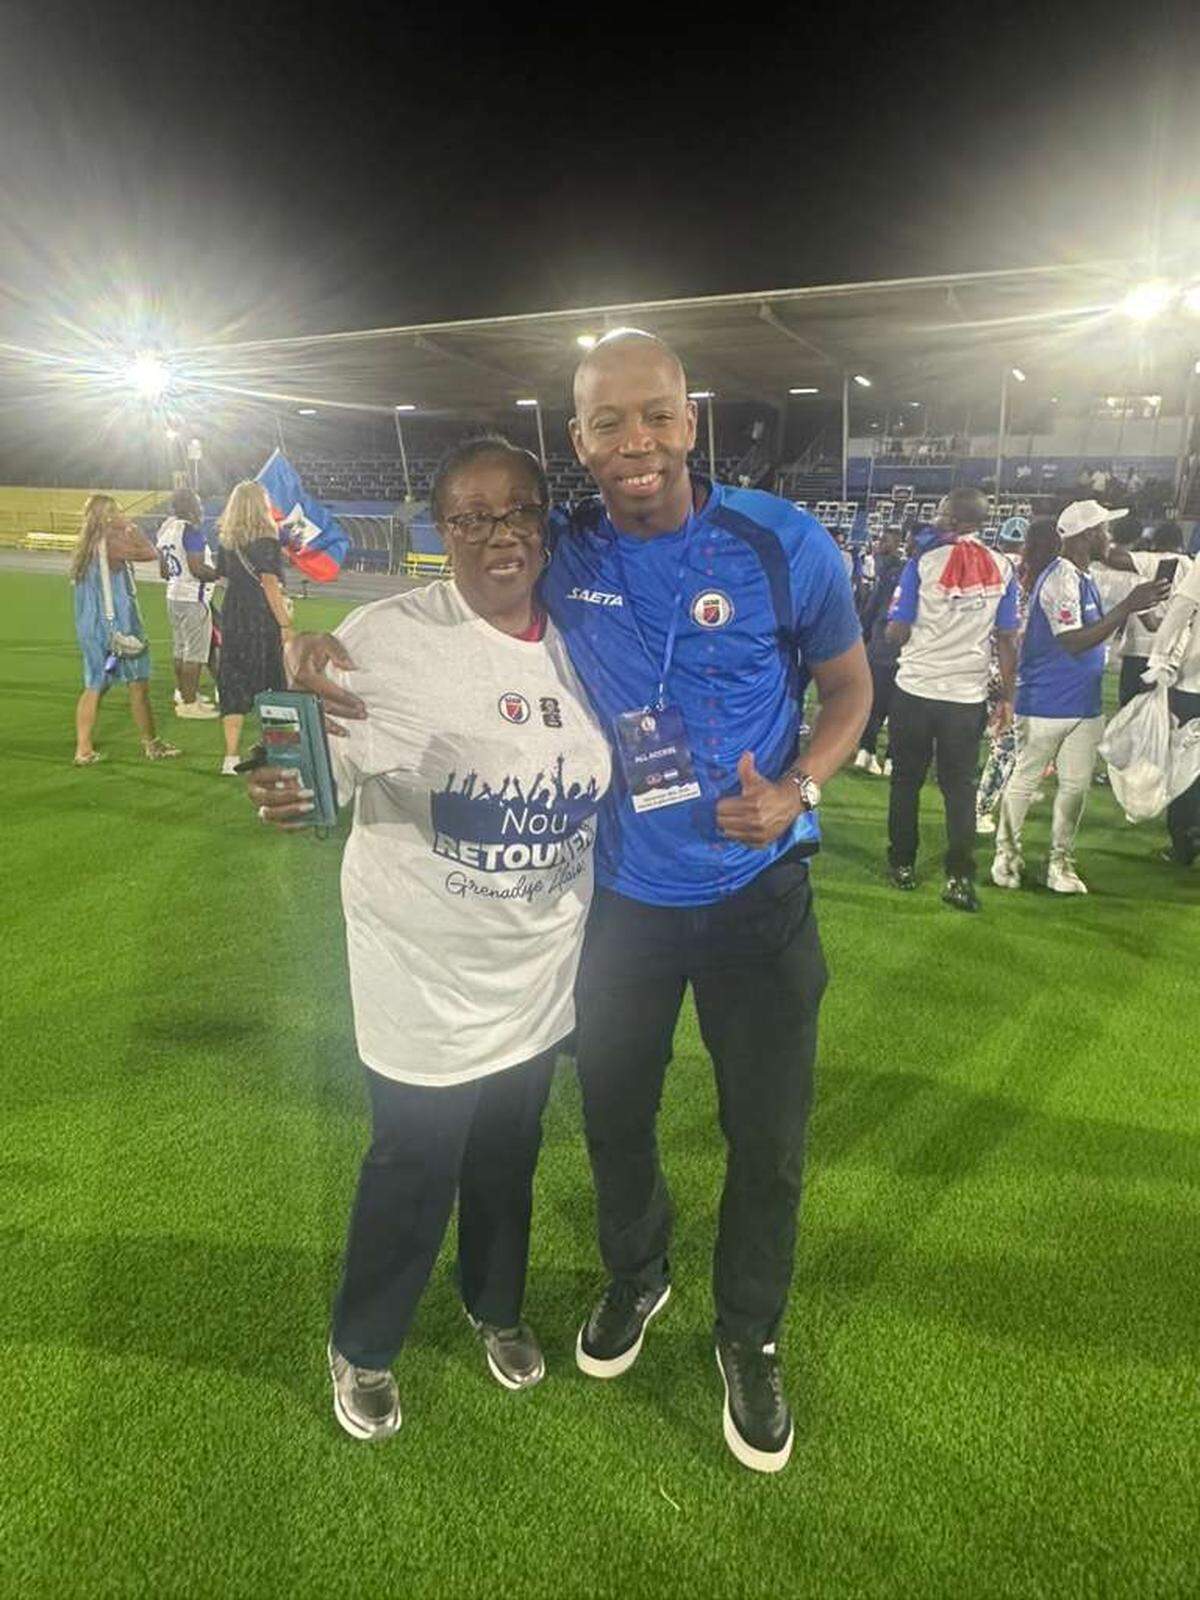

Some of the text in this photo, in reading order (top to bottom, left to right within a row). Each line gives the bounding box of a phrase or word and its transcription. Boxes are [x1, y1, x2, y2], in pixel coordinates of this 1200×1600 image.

[567, 587, 623, 606] SAETA
[501, 807, 567, 835] Nou
[445, 871, 543, 901] Grenadye
